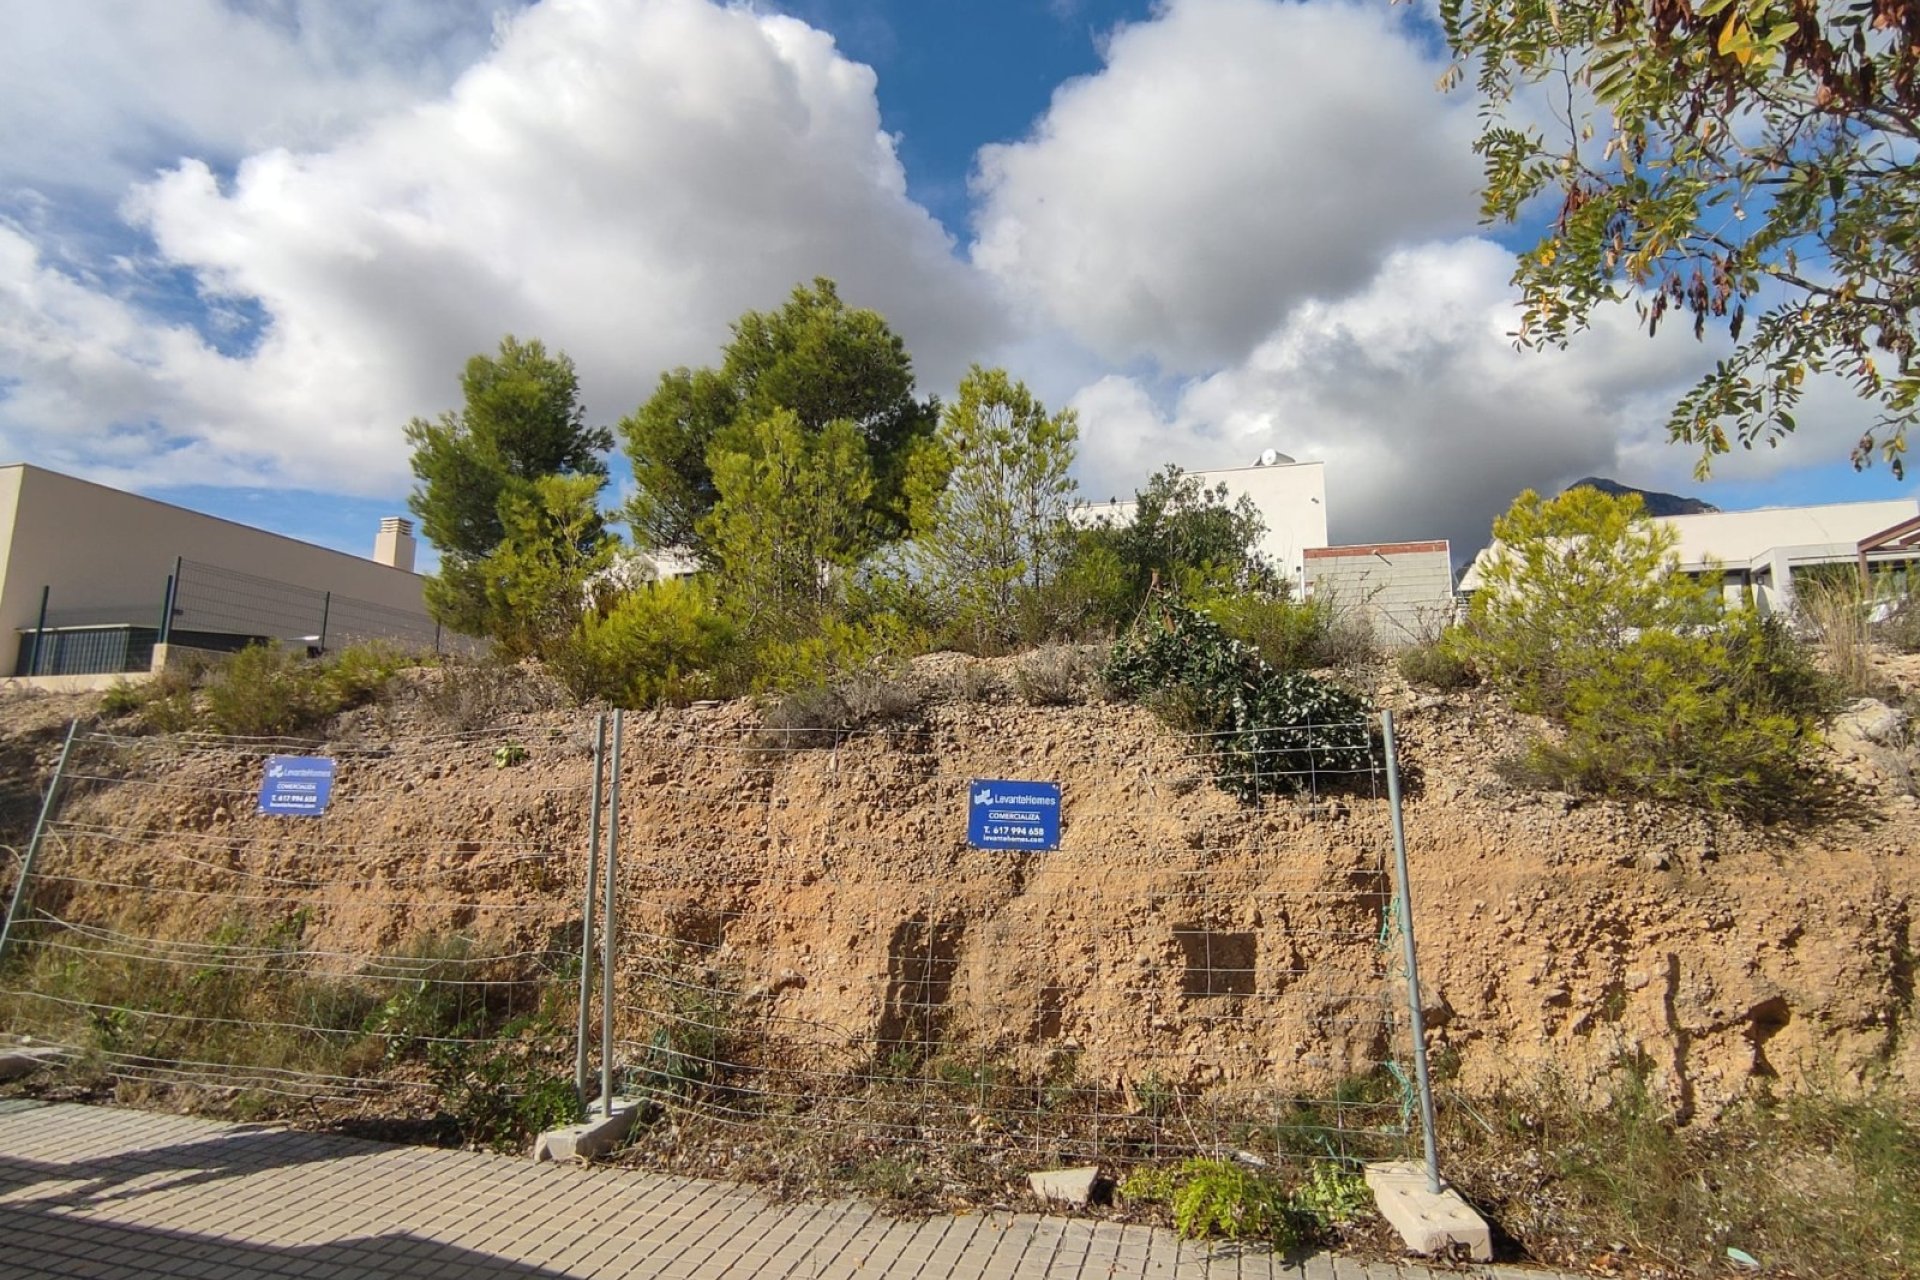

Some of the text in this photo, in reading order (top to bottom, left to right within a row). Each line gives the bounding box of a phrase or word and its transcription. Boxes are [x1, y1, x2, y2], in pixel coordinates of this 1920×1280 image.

[994, 794, 1056, 805] LevanteHomes
[988, 812, 1040, 821] COMERCIALIZA
[983, 826, 1044, 836] T. 617 994 658
[983, 834, 1044, 843] levantehomes.com
